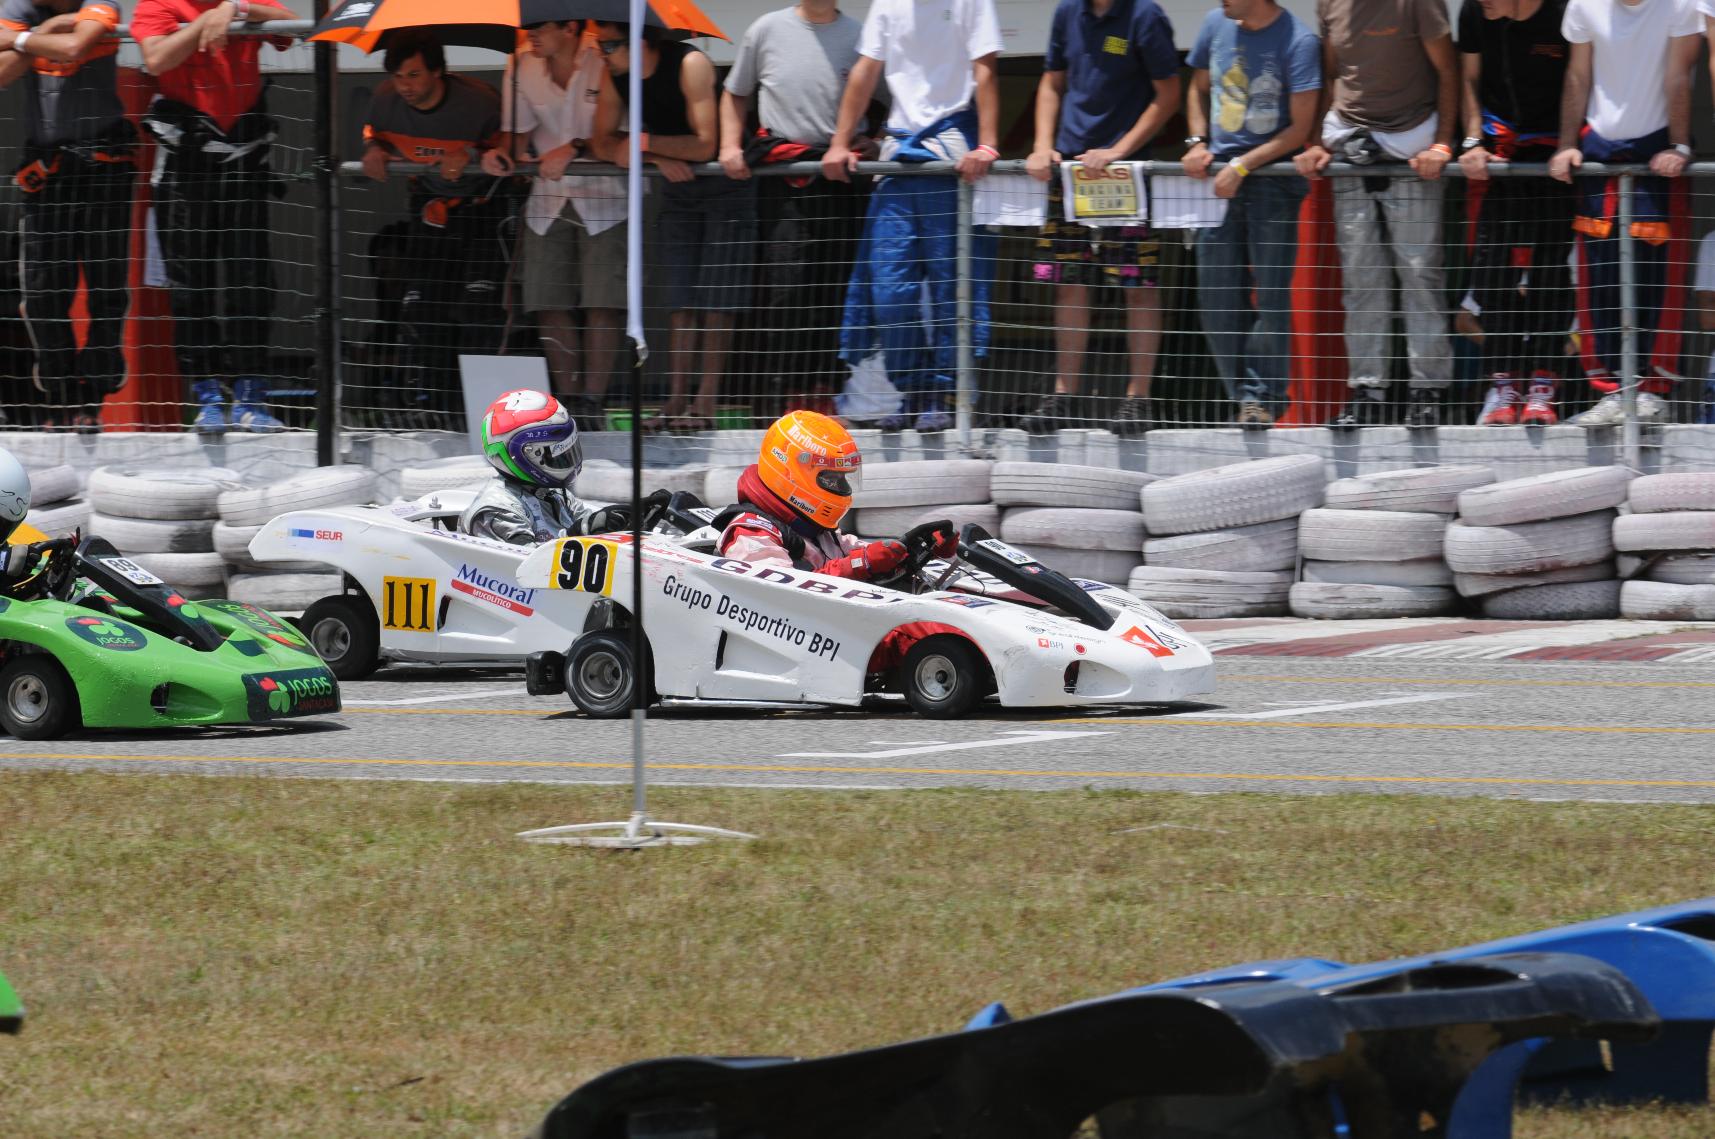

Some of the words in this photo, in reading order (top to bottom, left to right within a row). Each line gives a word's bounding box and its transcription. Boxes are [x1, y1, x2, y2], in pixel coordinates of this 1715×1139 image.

[787, 425, 827, 456] Marlboro
[789, 495, 815, 514] Marlboro
[315, 530, 343, 541] SEUR
[557, 539, 609, 593] 90
[457, 563, 534, 605] Mucoral
[384, 581, 430, 630] 111
[663, 575, 712, 610] Grupo
[716, 594, 806, 646] Desportivo
[808, 632, 841, 662] BPI
[96, 636, 135, 646] JOGOS
[287, 677, 333, 706] JOGOS
